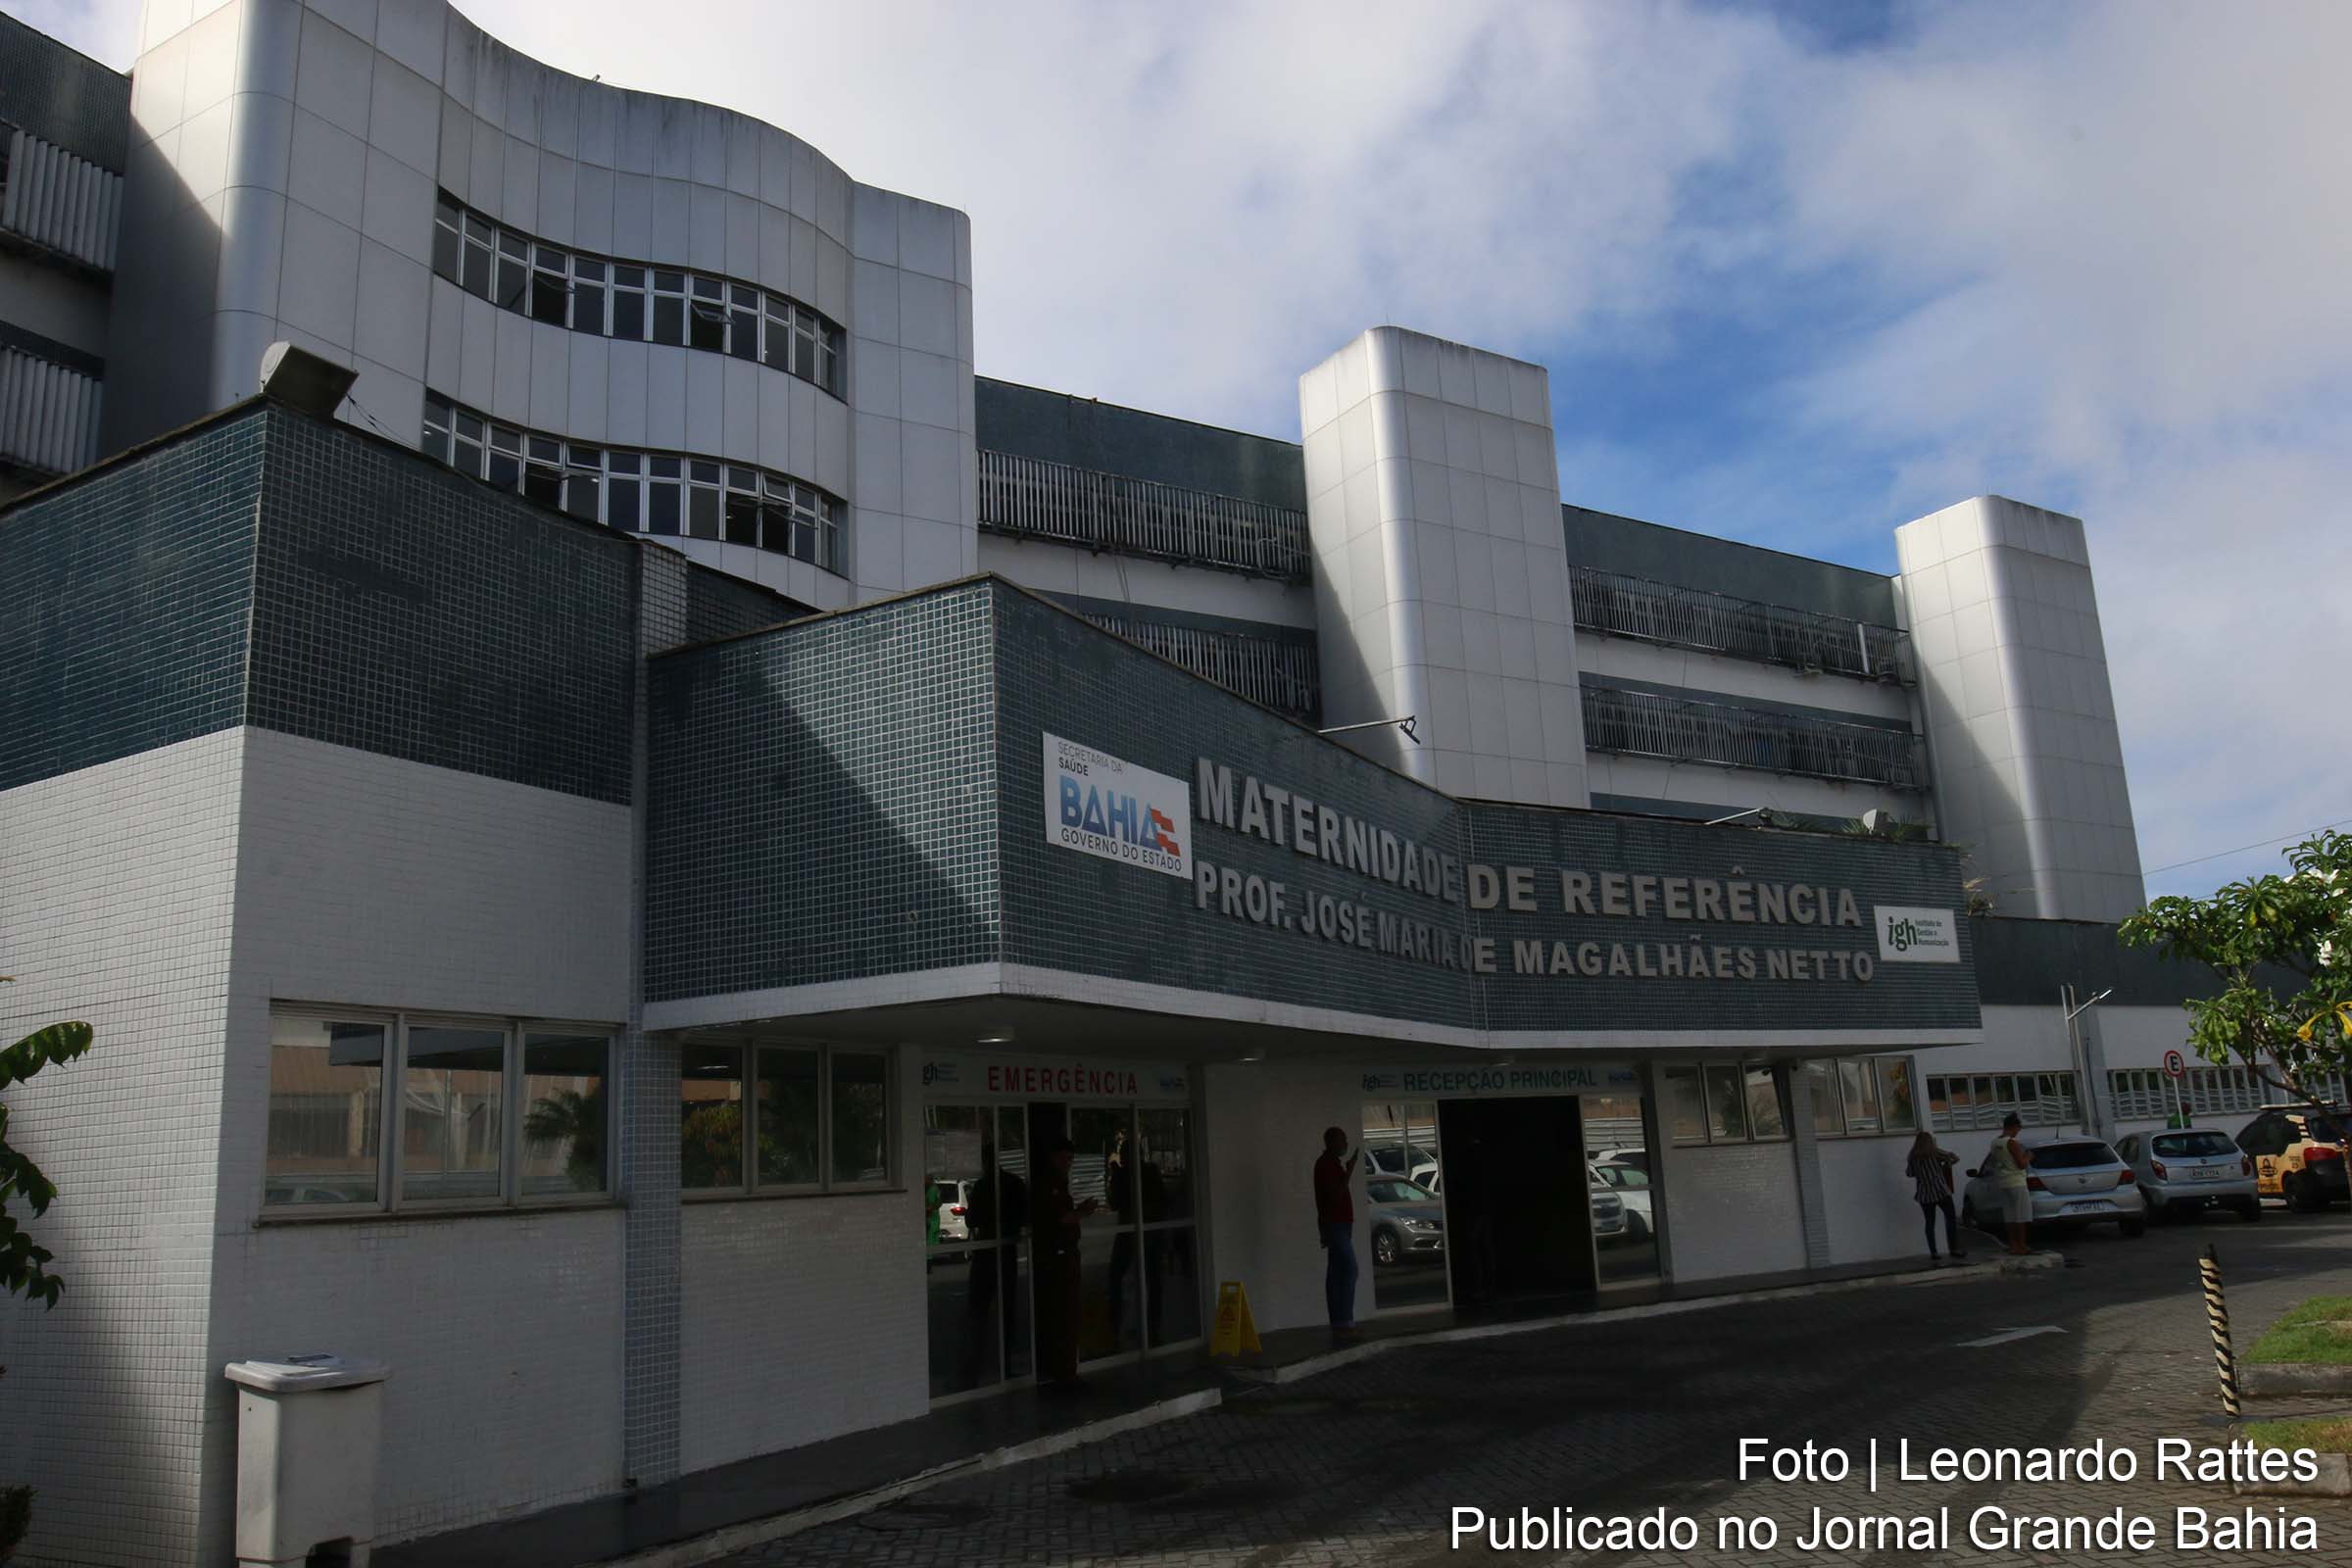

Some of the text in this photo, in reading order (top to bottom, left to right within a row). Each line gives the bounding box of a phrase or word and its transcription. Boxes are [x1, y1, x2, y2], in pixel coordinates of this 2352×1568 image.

[1057, 742, 1123, 773] SECRETARIA DA
[1058, 757, 1089, 776] SAÚDE
[1059, 774, 1164, 852] BAHIA
[1060, 828, 1182, 872] GOVERNO DO ESTADO
[1195, 757, 1862, 927] MATERNIDADE DE REFERÊNCIA
[1194, 860, 1293, 930] PROF.
[1301, 891, 1372, 949] JOSÉ
[1378, 911, 1457, 970] MARIA
[1513, 934, 1757, 979] MAGALHÃES
[1766, 949, 1875, 981] NETTO
[1887, 915, 1918, 952] igh
[987, 1063, 1139, 1094] EMERGÊNCIA
[1403, 1069, 1505, 1093] RECEPÇÃO
[1510, 1067, 1598, 1090] PRINCIPAL
[2169, 1054, 2180, 1072] E
